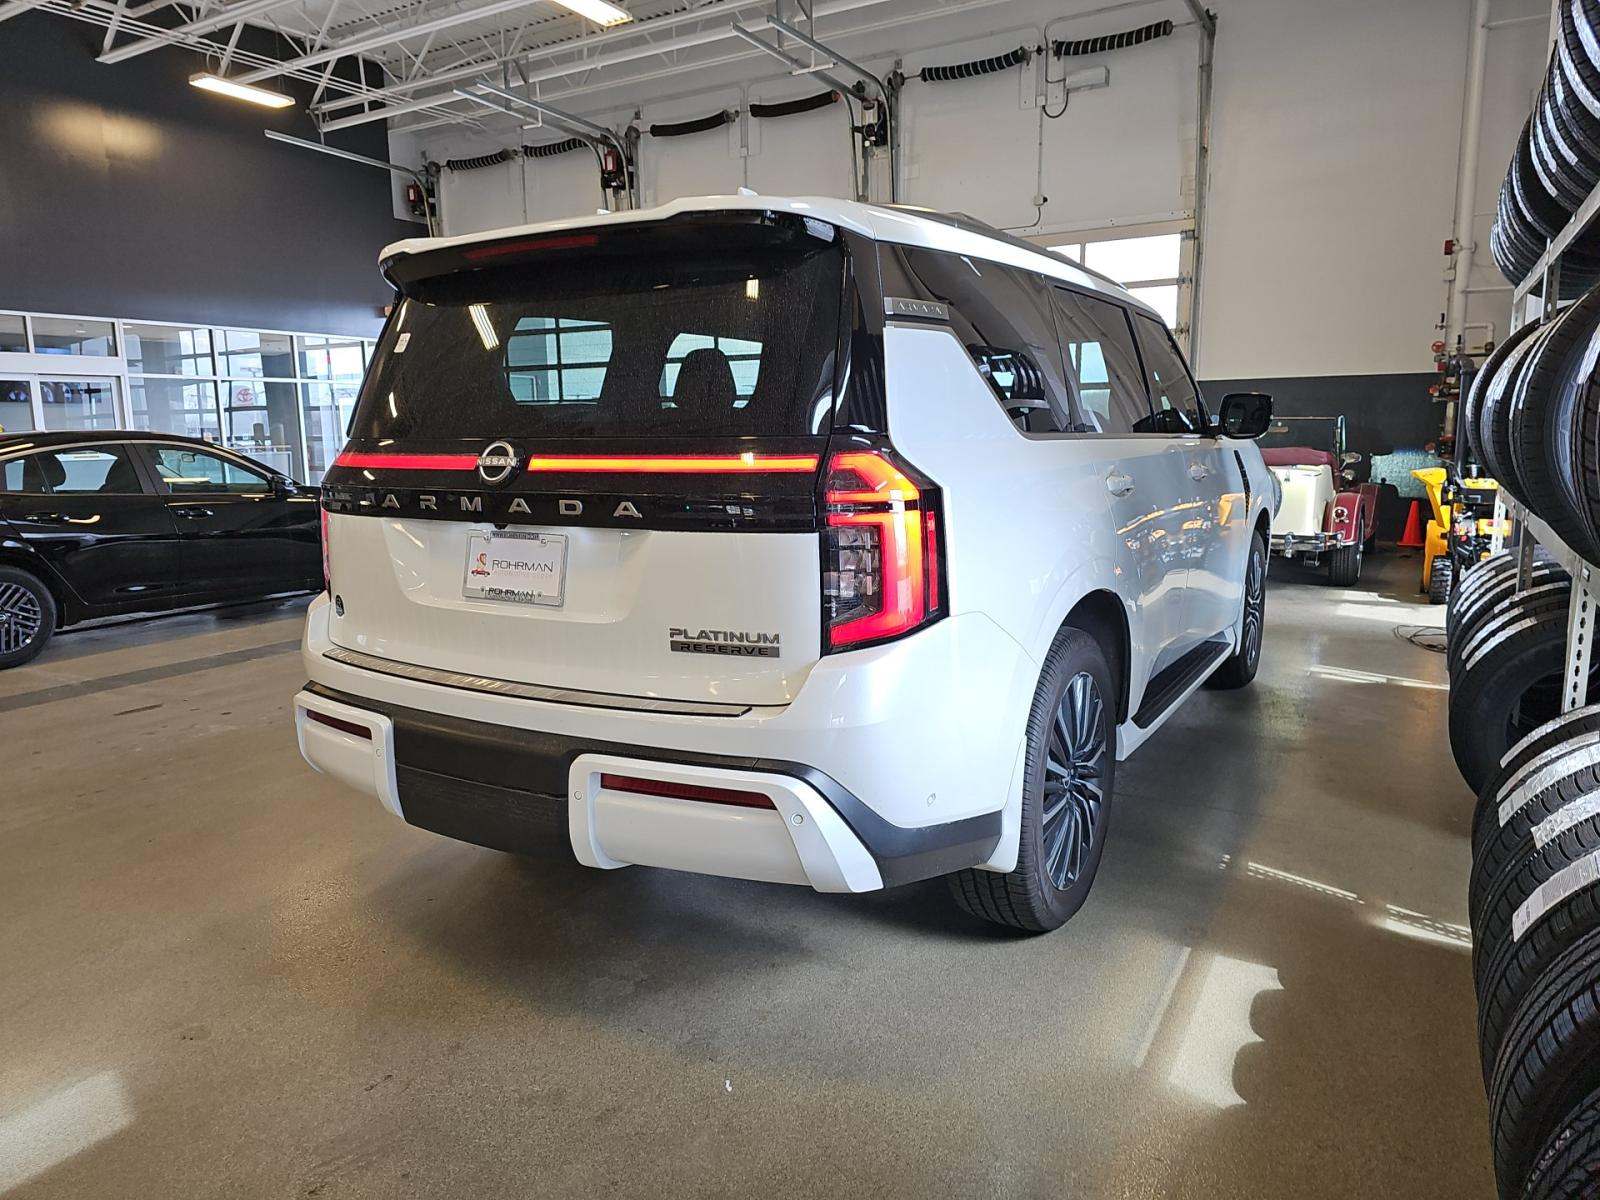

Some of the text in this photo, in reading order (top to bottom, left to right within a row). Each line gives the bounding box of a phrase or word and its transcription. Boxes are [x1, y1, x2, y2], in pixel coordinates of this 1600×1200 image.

[477, 457, 516, 467] NISSAN
[382, 493, 643, 518] ARMADA
[492, 559, 554, 573] ROHRMAN
[669, 627, 780, 644] PLATINUM
[679, 642, 769, 656] RESERVE
